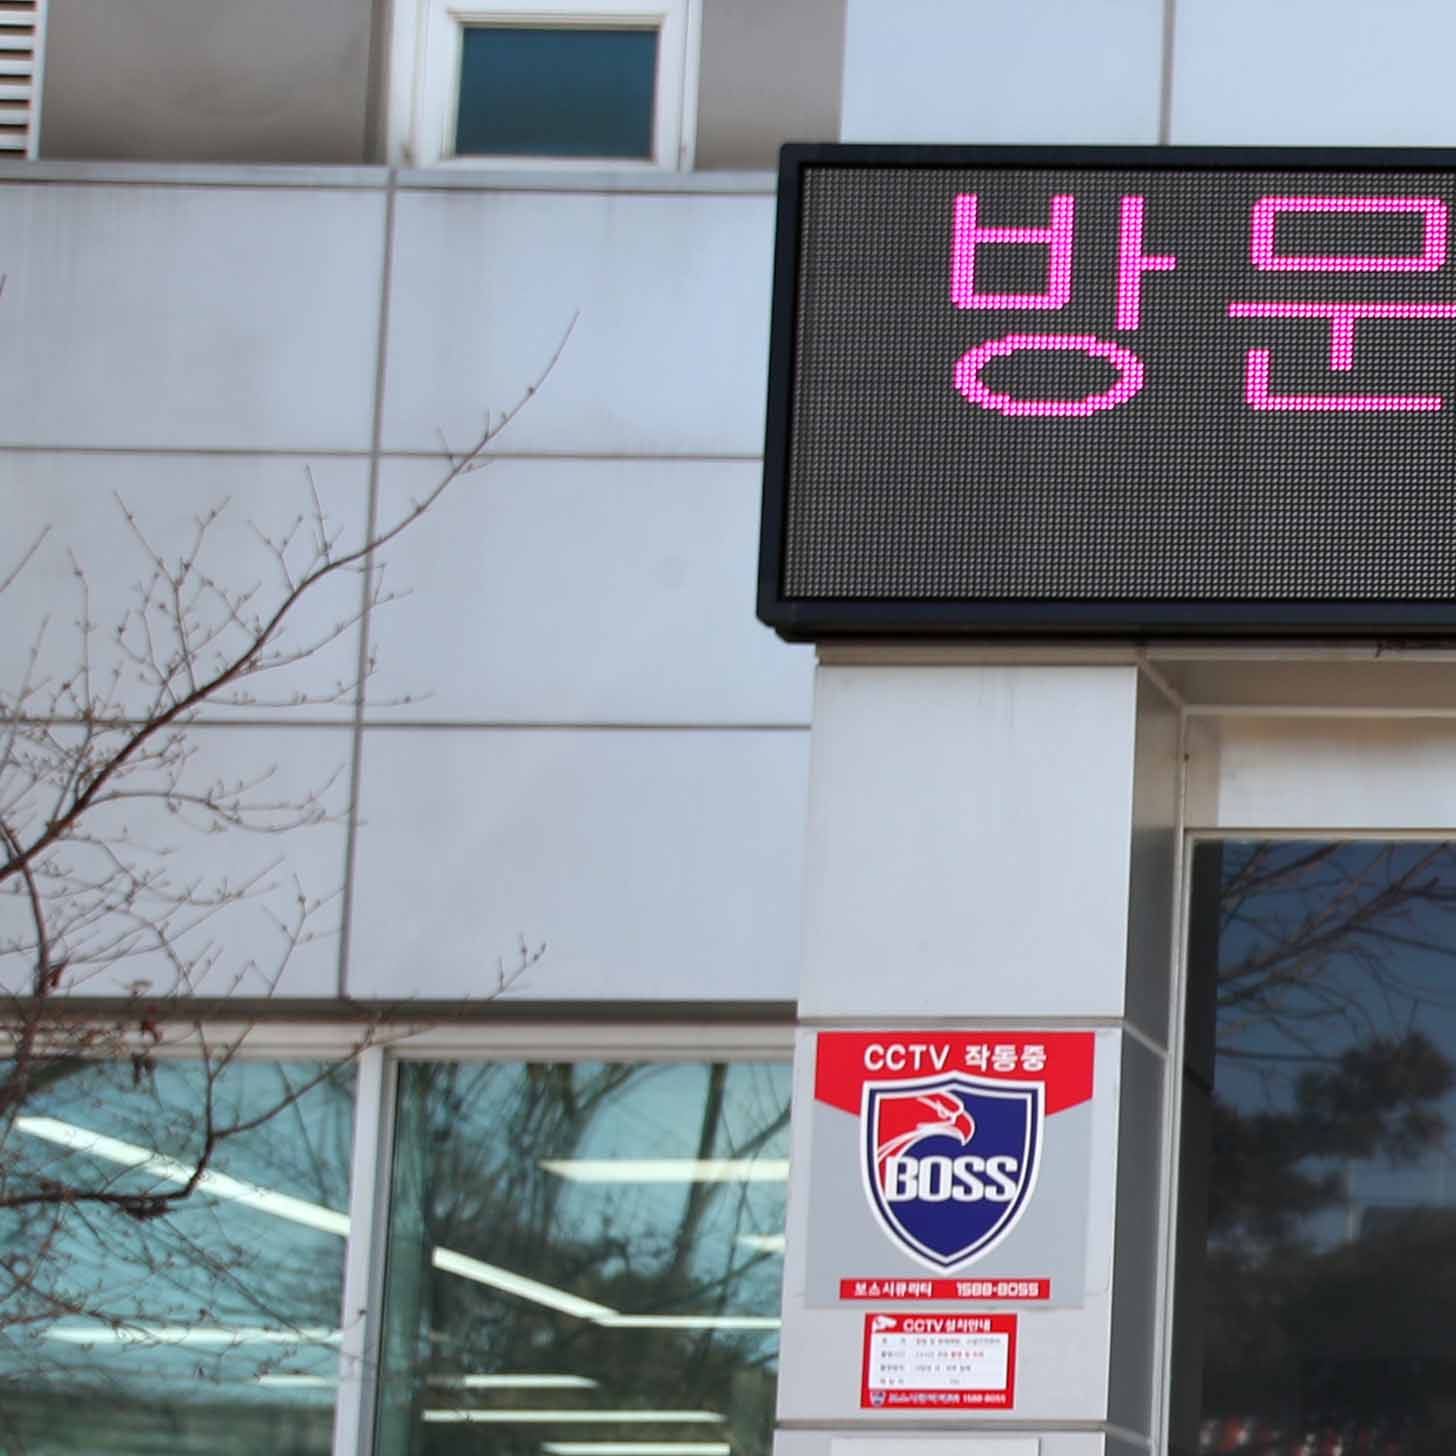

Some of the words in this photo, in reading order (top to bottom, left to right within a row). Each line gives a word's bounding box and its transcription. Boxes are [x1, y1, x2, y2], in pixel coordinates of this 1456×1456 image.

[864, 1044, 950, 1071] CCTV
[964, 1044, 1047, 1072] 작동중
[885, 1155, 1018, 1202] BOSS
[903, 1318, 944, 1332] CCTV
